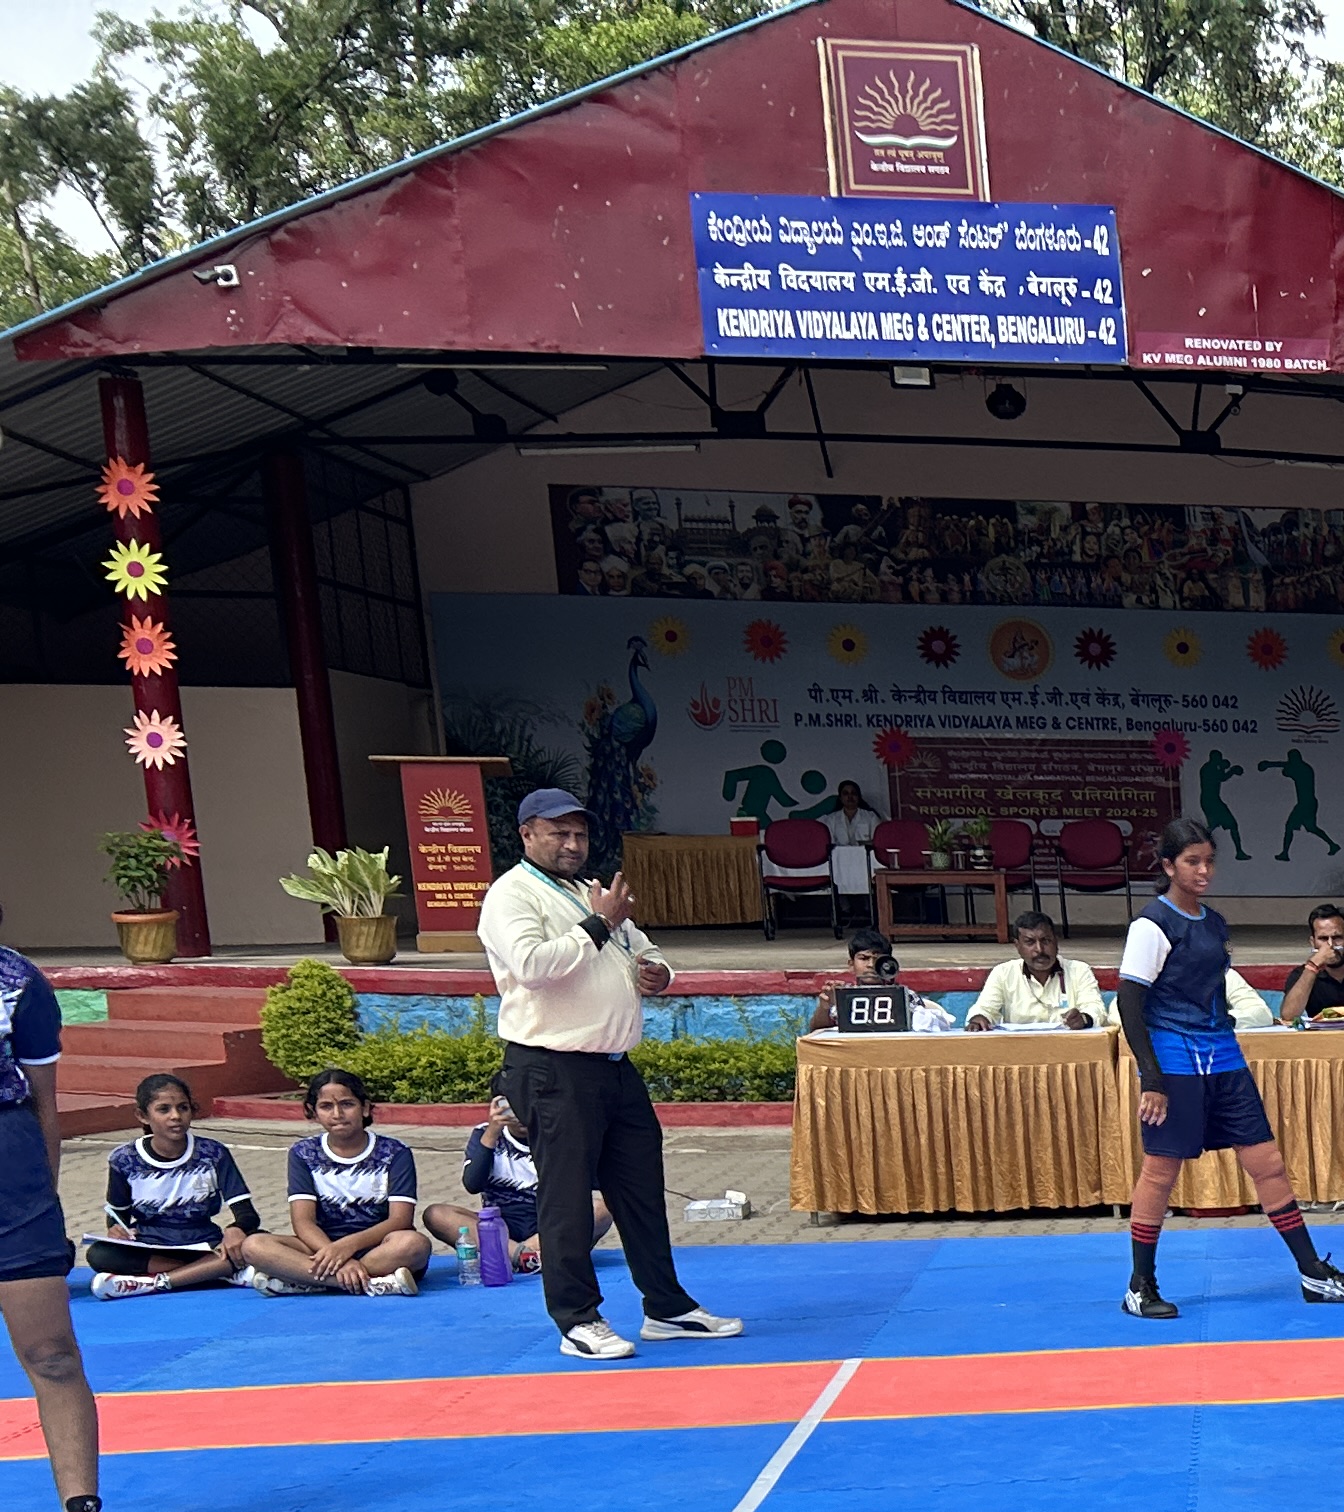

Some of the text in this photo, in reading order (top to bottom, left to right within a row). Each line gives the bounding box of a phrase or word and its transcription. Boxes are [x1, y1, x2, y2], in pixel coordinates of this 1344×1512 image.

[713, 262, 772, 292] केन्द्रीय
[716, 307, 796, 339] KENDRIYA
[795, 310, 879, 340] VIDYALAYA
[880, 312, 914, 341] MEG
[916, 312, 930, 342] &
[931, 312, 997, 349] CENTER,
[1185, 337, 1283, 352] RENOVATED BY
[1142, 353, 1162, 364] KV
[1164, 353, 1194, 365] MEG
[1196, 355, 1247, 368] ALUMNI
[1251, 357, 1282, 369] 1980
[727, 676, 754, 698] PM
[890, 683, 938, 706] केन्द्रीय
[940, 684, 997, 706] विद्यालय
[1212, 694, 1239, 709] 042
[728, 698, 780, 723] SHRI
[794, 712, 863, 728] P.M.SHRI.
[866, 714, 936, 729] KENDRIYA
[937, 714, 1013, 730] VIDYALAYA
[1016, 716, 1047, 730] MEG
[1051, 716, 1062, 730] &
[1065, 717, 1123, 734] CENTRE,
[1232, 719, 1258, 734] 042
[913, 784, 1158, 804] संभागीय खेलकूद प्रतियोगिता
[919, 805, 1159, 818] REGIONAL SPORTS MEET 2024-25
